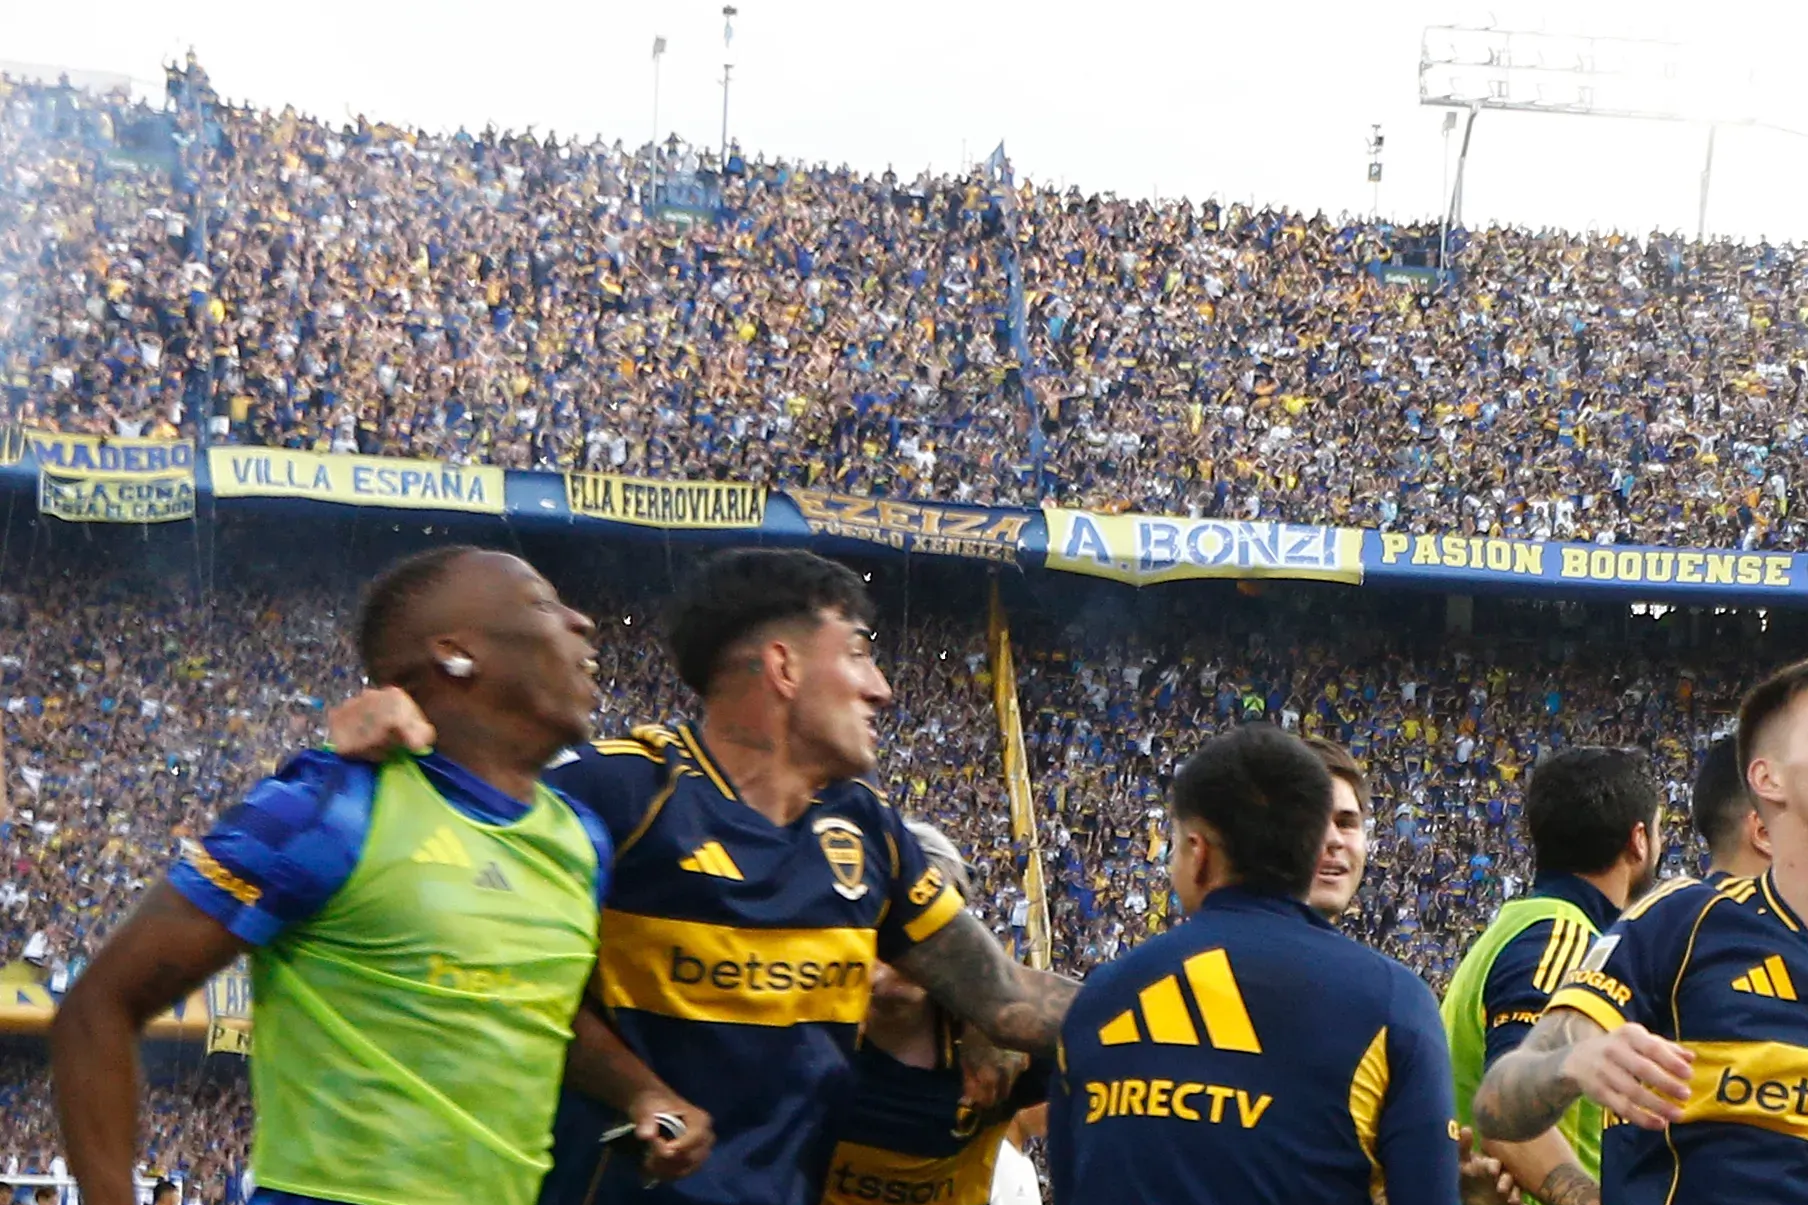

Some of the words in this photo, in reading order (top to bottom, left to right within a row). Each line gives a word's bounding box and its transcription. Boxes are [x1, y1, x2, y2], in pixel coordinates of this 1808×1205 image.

[33, 440, 192, 471] MADERO
[232, 456, 331, 490] VILLA
[353, 464, 486, 503] ESPAÑA
[622, 484, 763, 522] FERROVIARIA
[800, 490, 1032, 541] EZEIZA
[1380, 533, 1543, 576] PASION
[1560, 547, 1793, 586] BOQUENSE
[1086, 1078, 1274, 1129] DIRECTV
